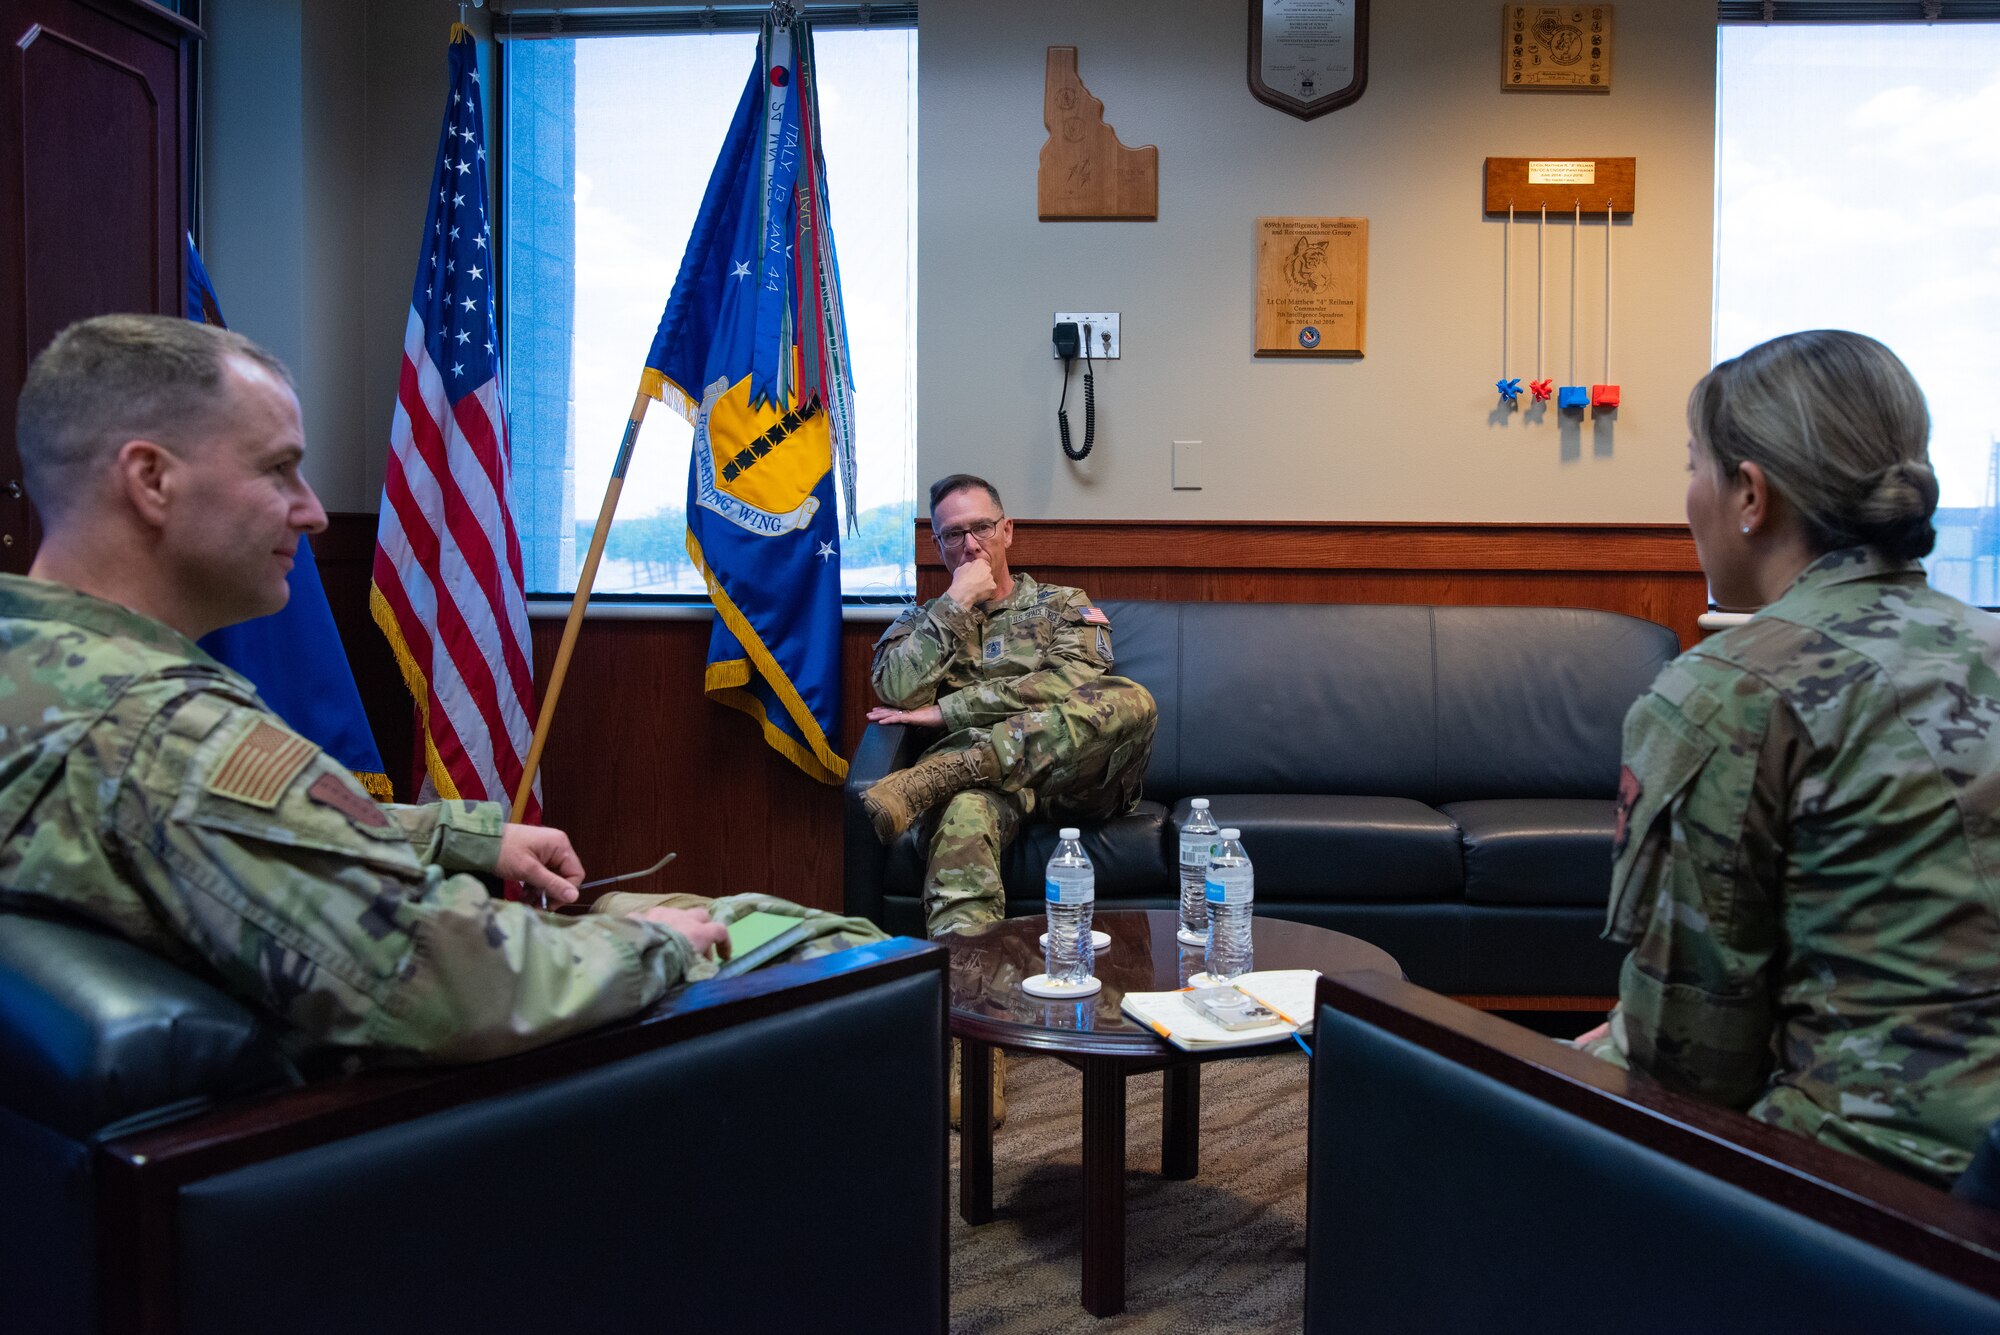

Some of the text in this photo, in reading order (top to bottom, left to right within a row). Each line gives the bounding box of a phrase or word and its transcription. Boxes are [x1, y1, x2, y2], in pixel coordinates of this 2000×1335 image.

[775, 184, 787, 202] 13
[770, 214, 781, 253] JAN
[766, 266, 780, 292] 44
[699, 448, 733, 511] TRAINING
[738, 504, 782, 532] WING
[1025, 609, 1042, 618] SPACE
[1045, 609, 1060, 623] FRCE
